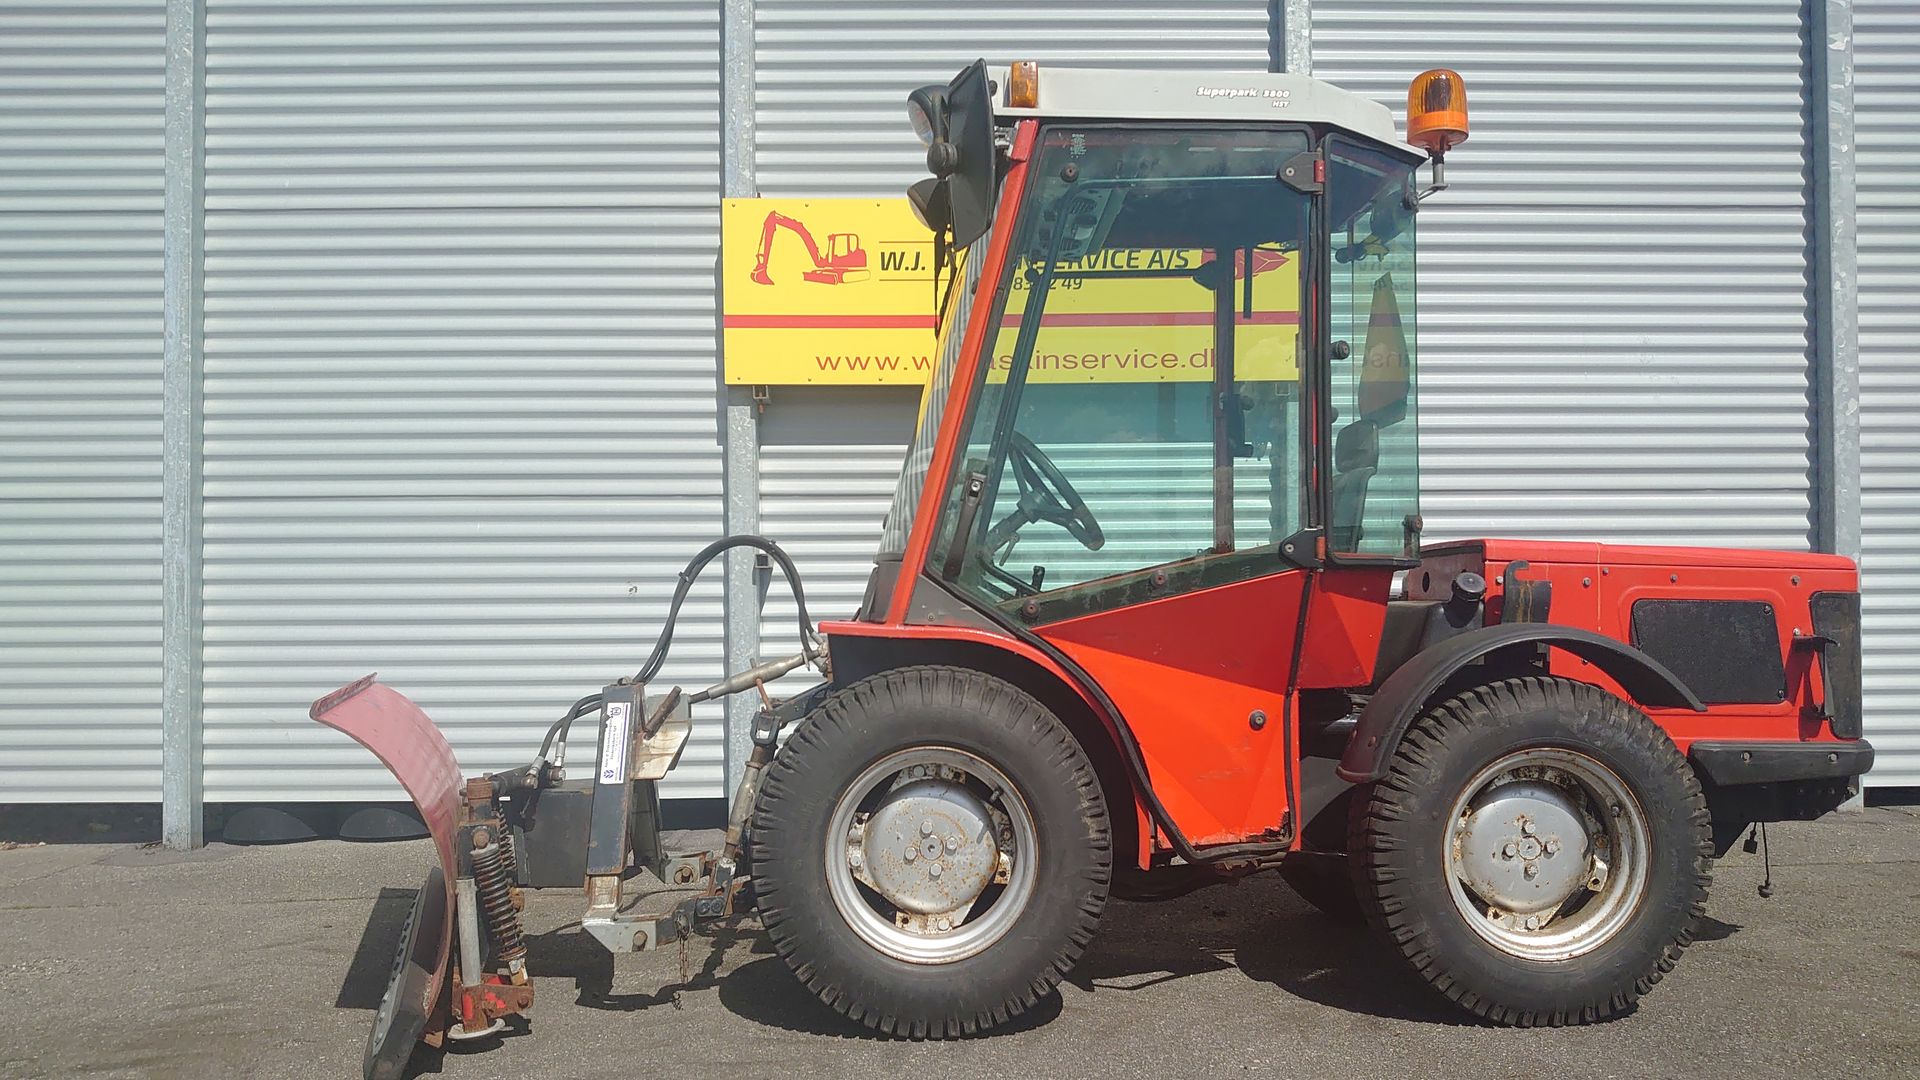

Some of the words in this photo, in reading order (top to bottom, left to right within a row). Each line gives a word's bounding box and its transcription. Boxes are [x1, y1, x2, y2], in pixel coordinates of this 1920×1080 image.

[1196, 86, 1258, 99] Superpark
[880, 251, 926, 271] W.J.
[1146, 248, 1190, 270] A/S
